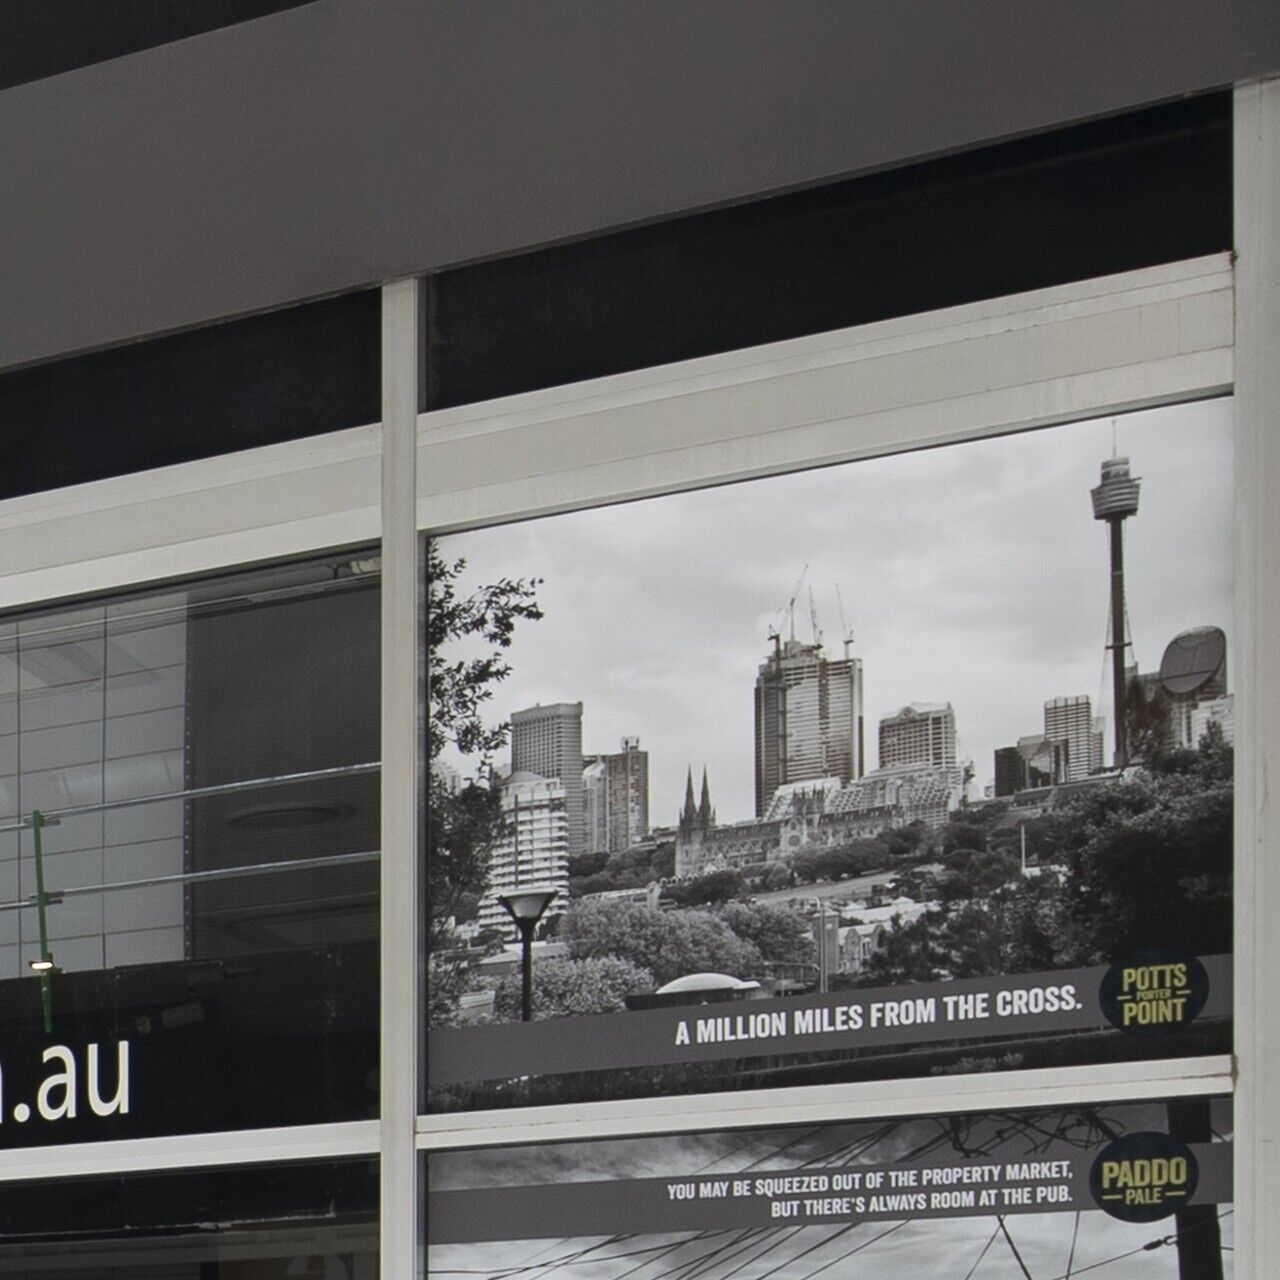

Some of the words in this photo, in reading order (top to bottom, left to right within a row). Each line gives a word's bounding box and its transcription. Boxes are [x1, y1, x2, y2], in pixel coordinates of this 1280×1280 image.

[1122, 964, 1186, 989] POTTS
[1136, 988, 1171, 1001] PORTER
[675, 1021, 690, 1045] A
[696, 1013, 787, 1043] MILLION
[793, 1004, 863, 1036] MILES
[871, 998, 935, 1028] FROM
[943, 992, 989, 1021] THE
[995, 985, 1083, 1016] CROSS.
[1123, 999, 1186, 1026] POINT
[668, 1183, 696, 1201] YOU
[699, 1181, 730, 1199] MAY
[733, 1179, 752, 1197] BE
[755, 1175, 829, 1196] SQUEEZED
[832, 1172, 862, 1191] OUT
[865, 1170, 885, 1189] OF
[889, 1169, 918, 1187] THE
[922, 1165, 1002, 1186] PROPERTY
[1005, 1161, 1073, 1182] MARKET,
[1102, 1157, 1186, 1188] PADDO
[770, 1201, 800, 1218] BUT
[804, 1197, 866, 1216] THERE'S
[869, 1194, 928, 1213] ALWAYS
[931, 1192, 974, 1210] ROOM
[978, 1190, 998, 1207] AT
[1001, 1188, 1032, 1205] THE
[1036, 1185, 1073, 1204] PUB.
[1125, 1187, 1162, 1205] PALE
